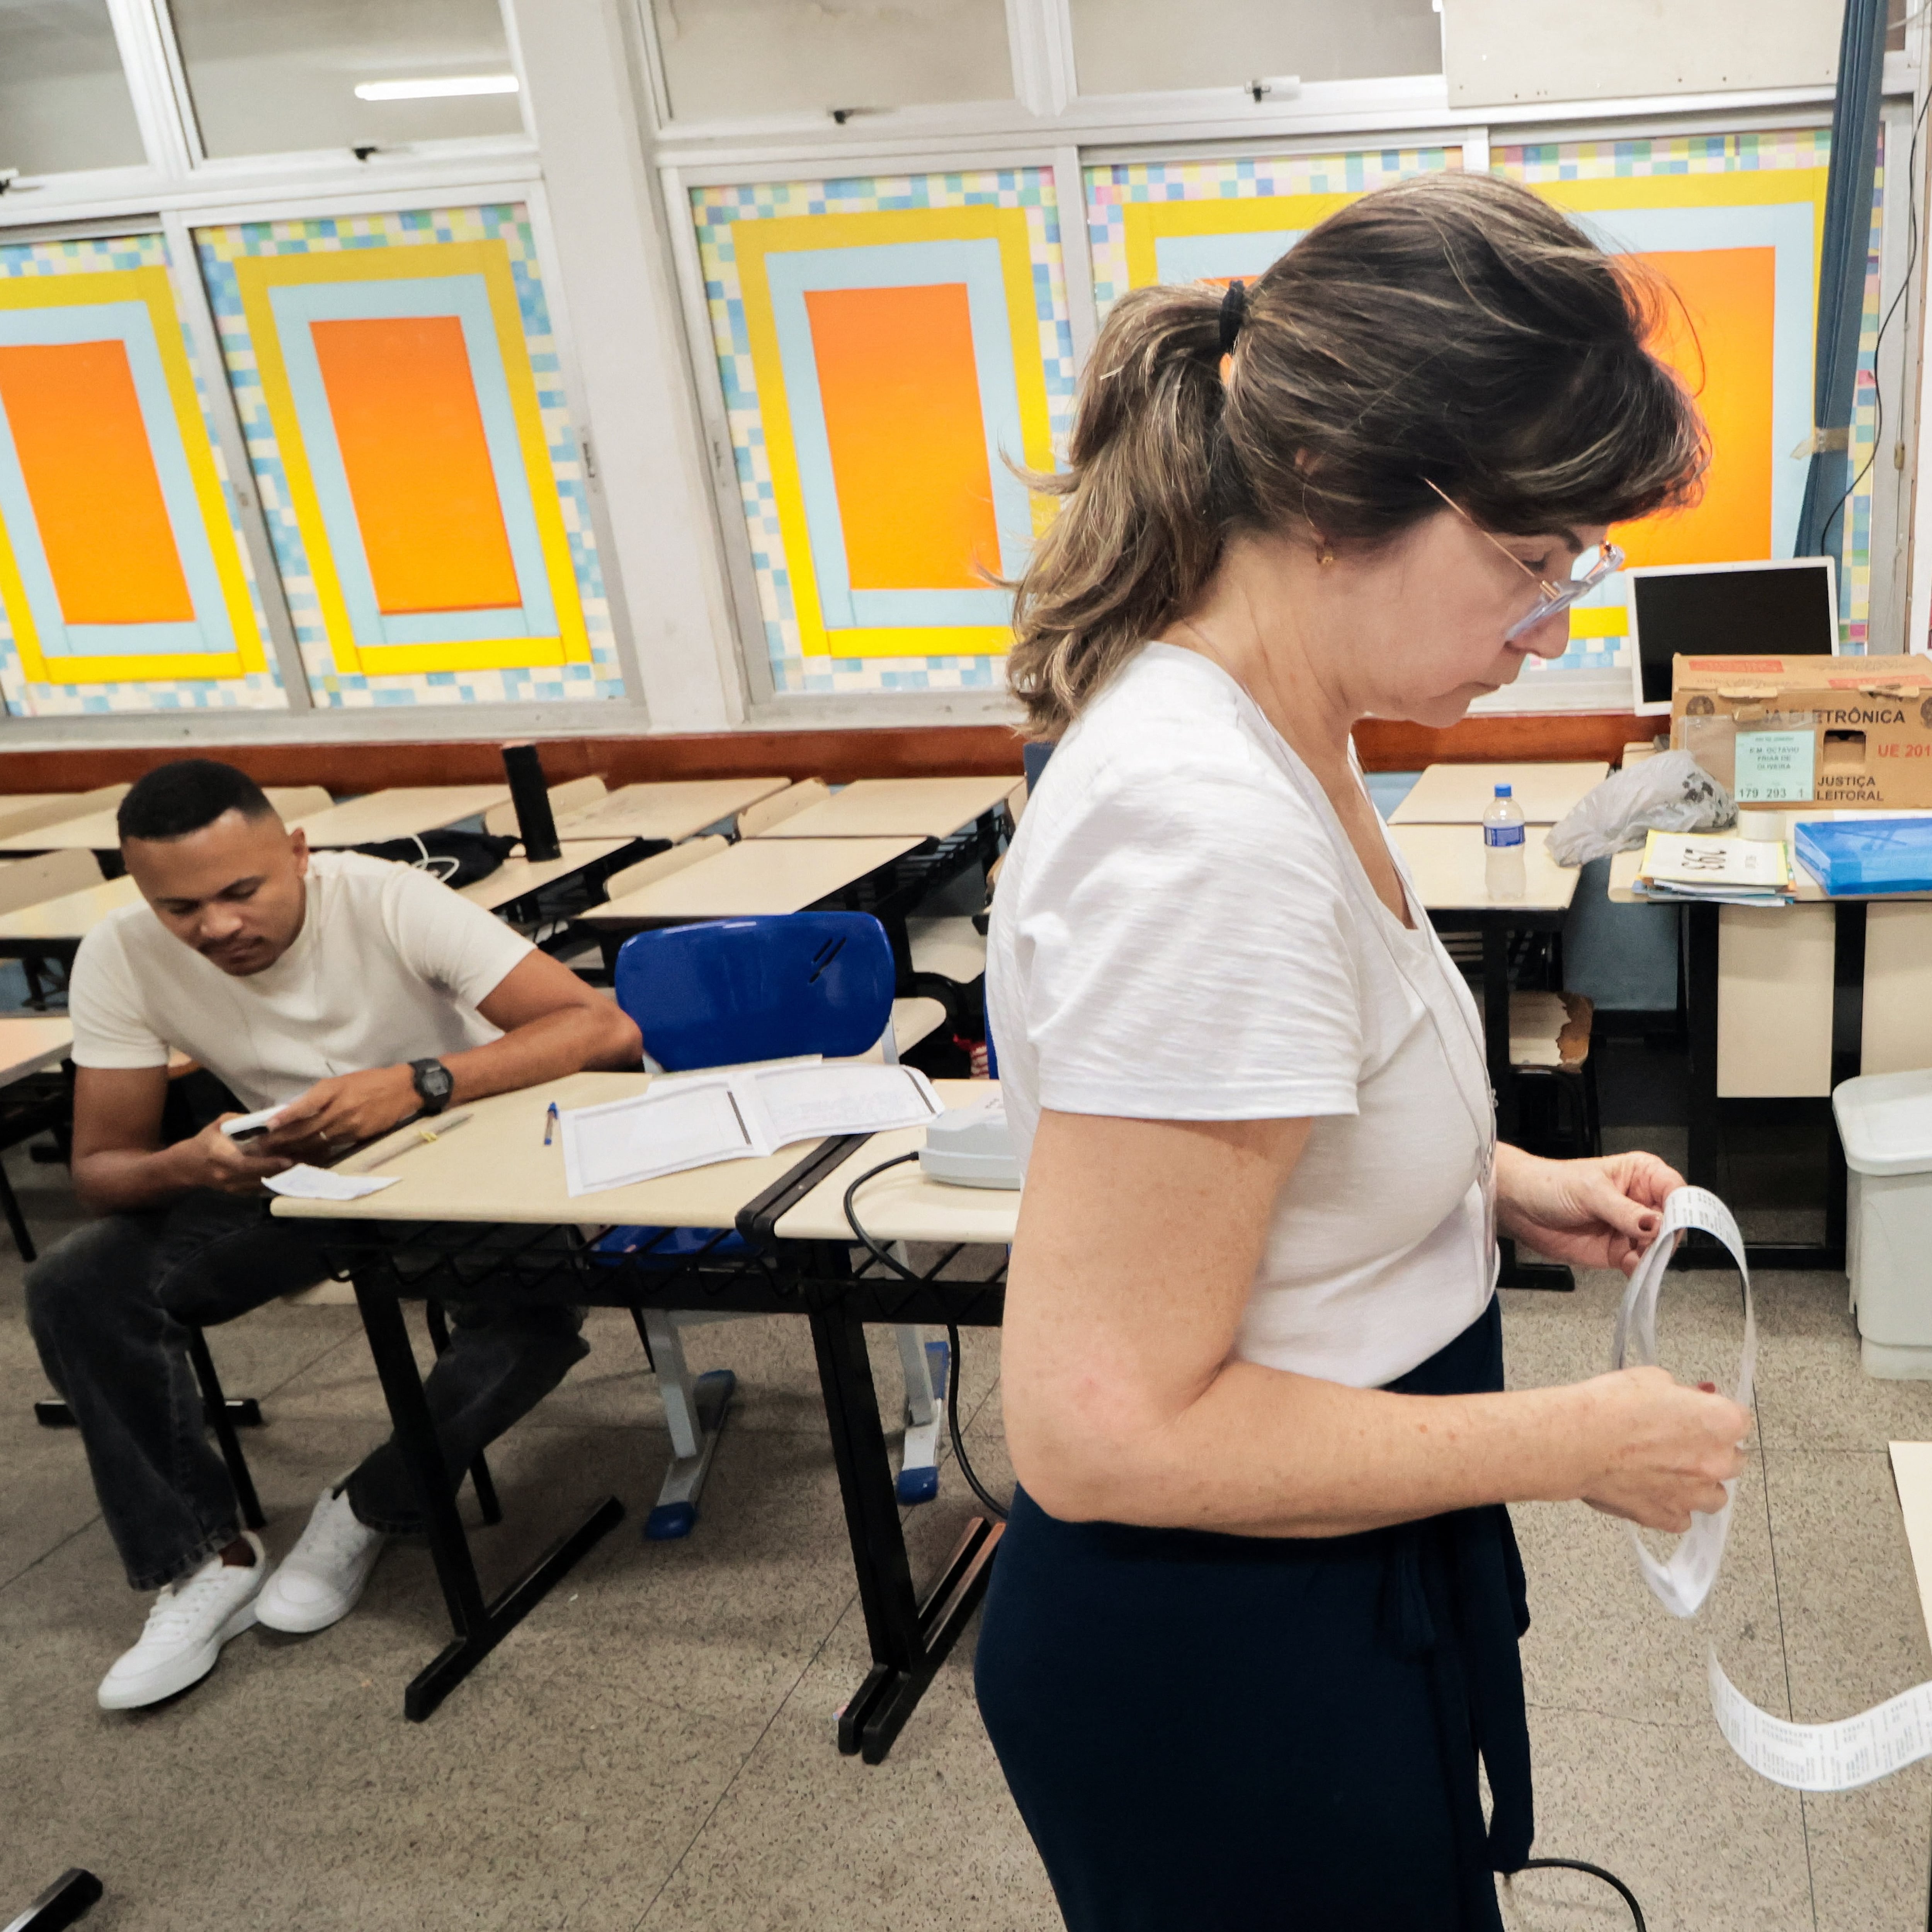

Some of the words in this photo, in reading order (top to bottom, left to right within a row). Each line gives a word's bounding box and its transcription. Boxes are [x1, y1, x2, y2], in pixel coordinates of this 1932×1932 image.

[1878, 744, 1900, 758] UE
[1817, 776, 1876, 788] JUSTIÇA
[1740, 787, 1759, 798] 179
[1814, 790, 1884, 801] LEITORAL
